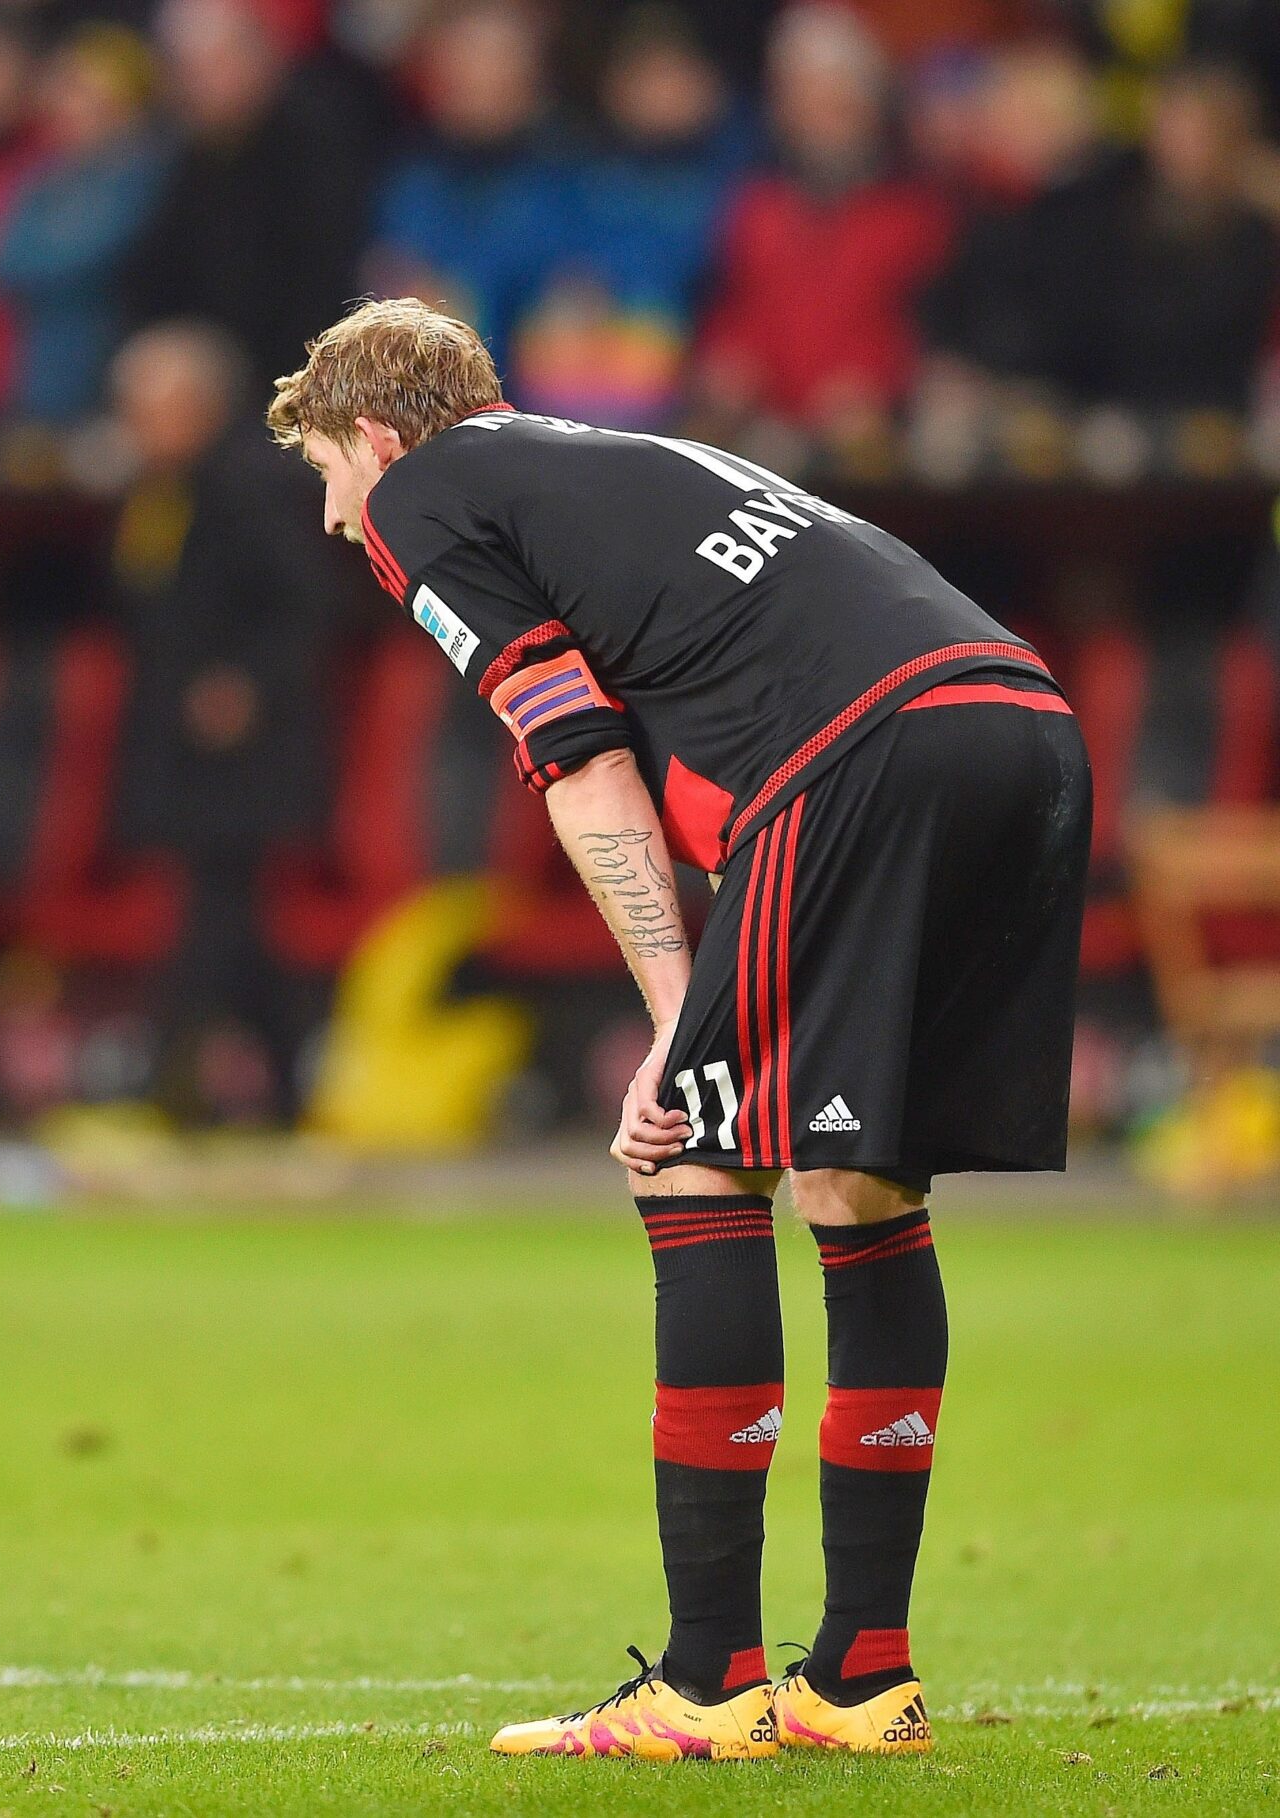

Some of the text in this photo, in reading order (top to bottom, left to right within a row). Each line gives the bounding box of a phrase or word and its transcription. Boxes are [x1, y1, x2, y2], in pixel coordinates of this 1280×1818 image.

[448, 627, 469, 664] rmes
[674, 1060, 739, 1150] 11
[808, 1118, 862, 1133] adidas
[860, 1433, 934, 1447] adidas
